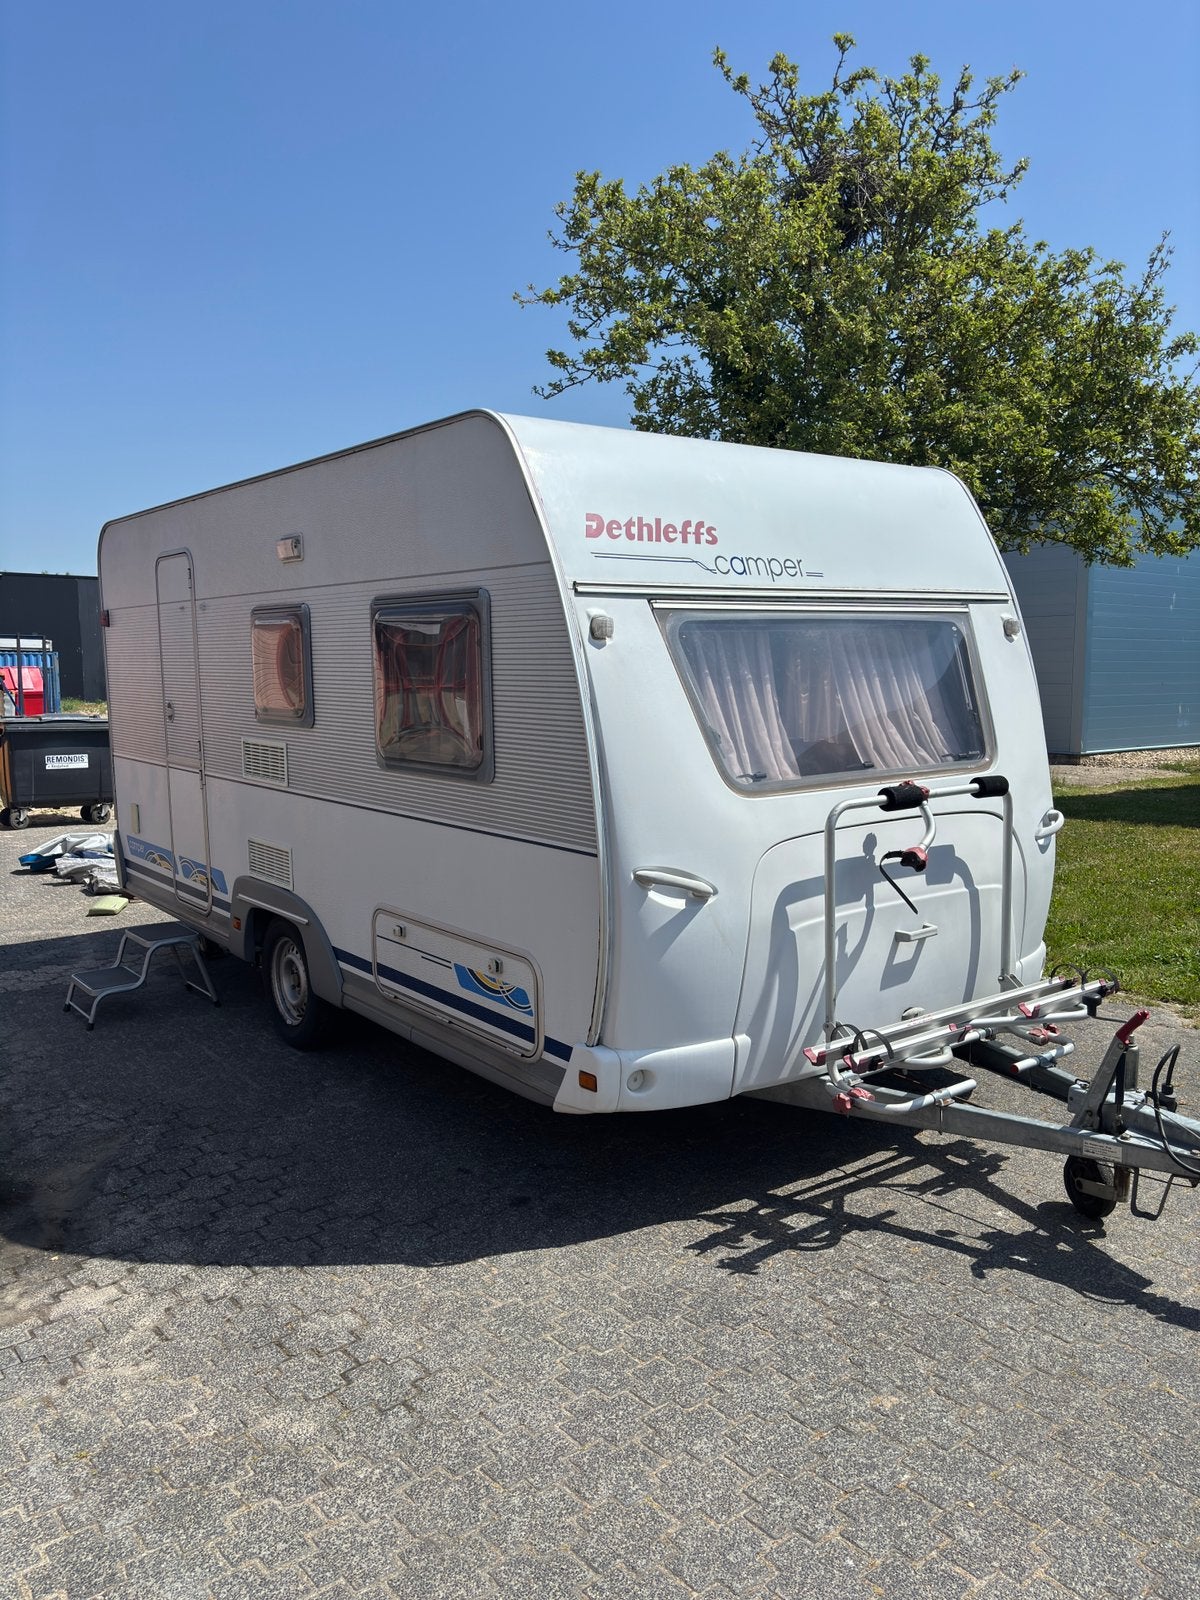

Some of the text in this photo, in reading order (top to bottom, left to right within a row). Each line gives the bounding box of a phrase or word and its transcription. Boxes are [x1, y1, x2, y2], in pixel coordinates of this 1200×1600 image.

[585, 512, 718, 545] Dethleffs
[714, 555, 803, 582] camper
[46, 755, 85, 763] REMONDIS
